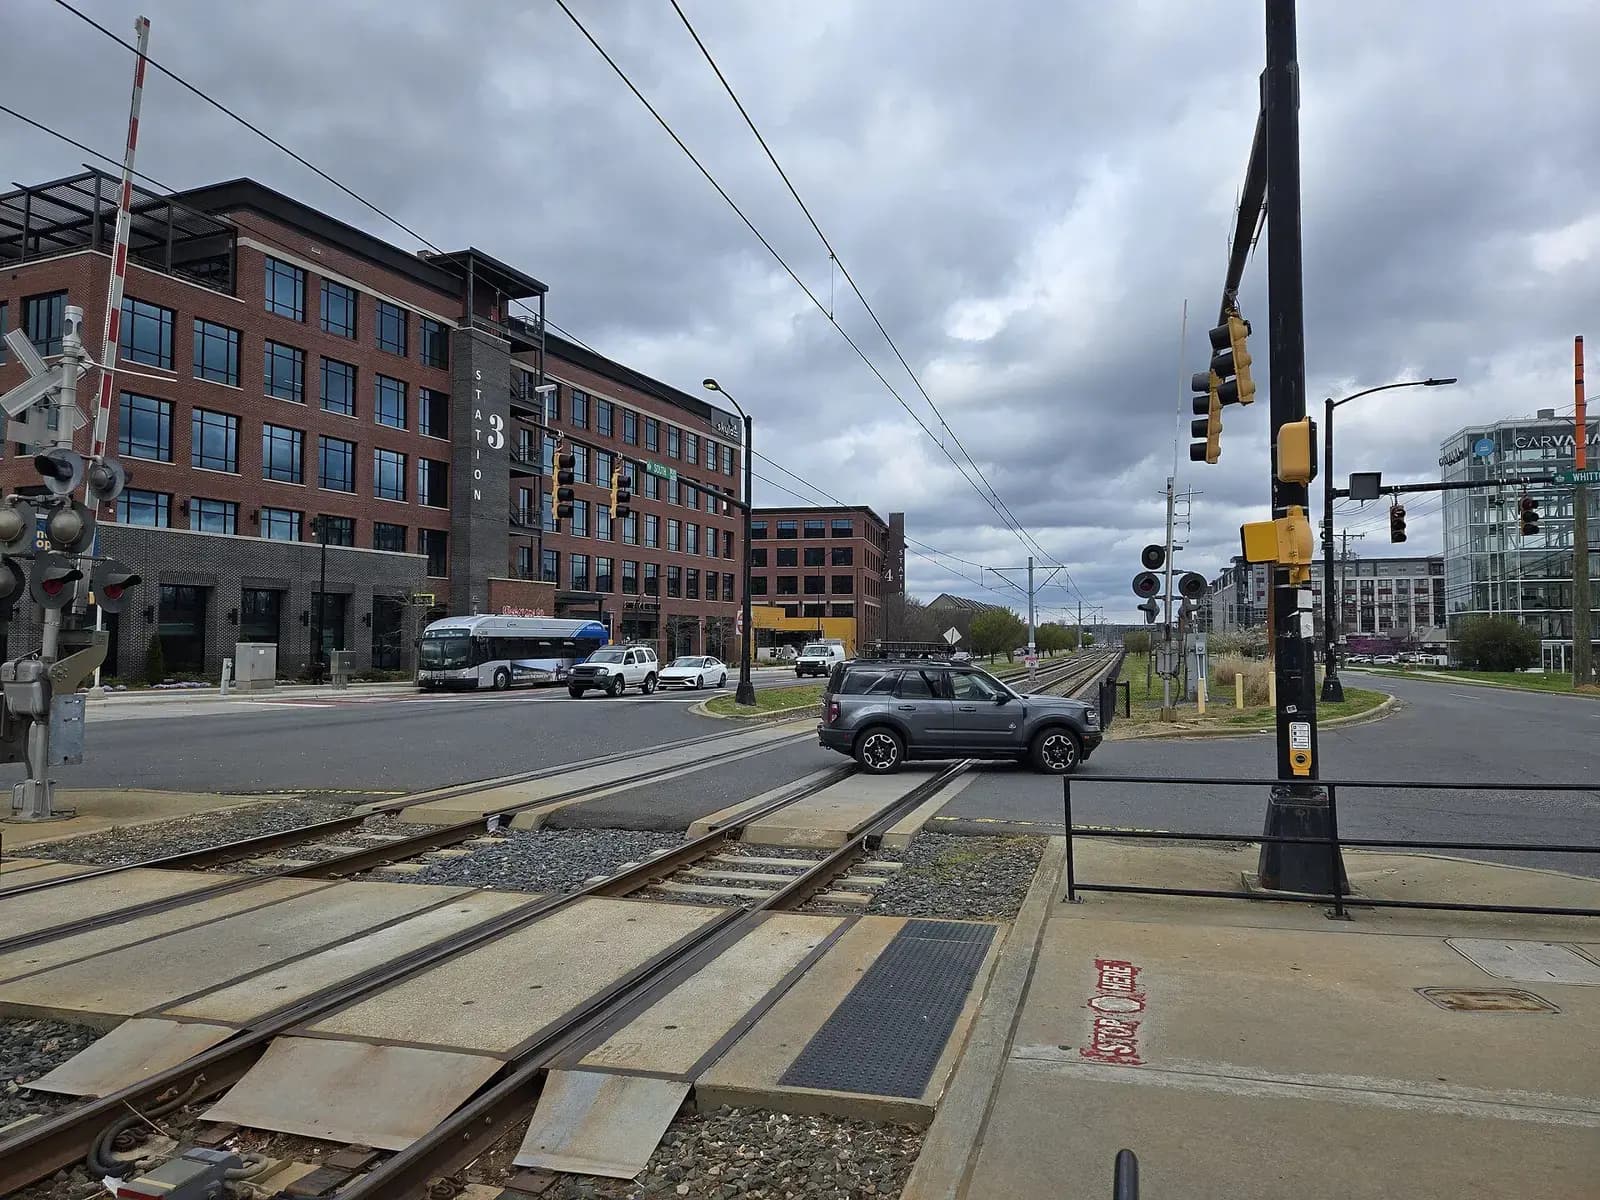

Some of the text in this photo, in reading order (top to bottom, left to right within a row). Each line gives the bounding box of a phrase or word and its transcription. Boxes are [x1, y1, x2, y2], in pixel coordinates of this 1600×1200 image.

[474, 370, 482, 501] STATION
[487, 414, 505, 450] 3
[1572, 472, 1600, 481] WHITT
[884, 568, 894, 582] 4
[1096, 965, 1138, 1055] STOP HERE
